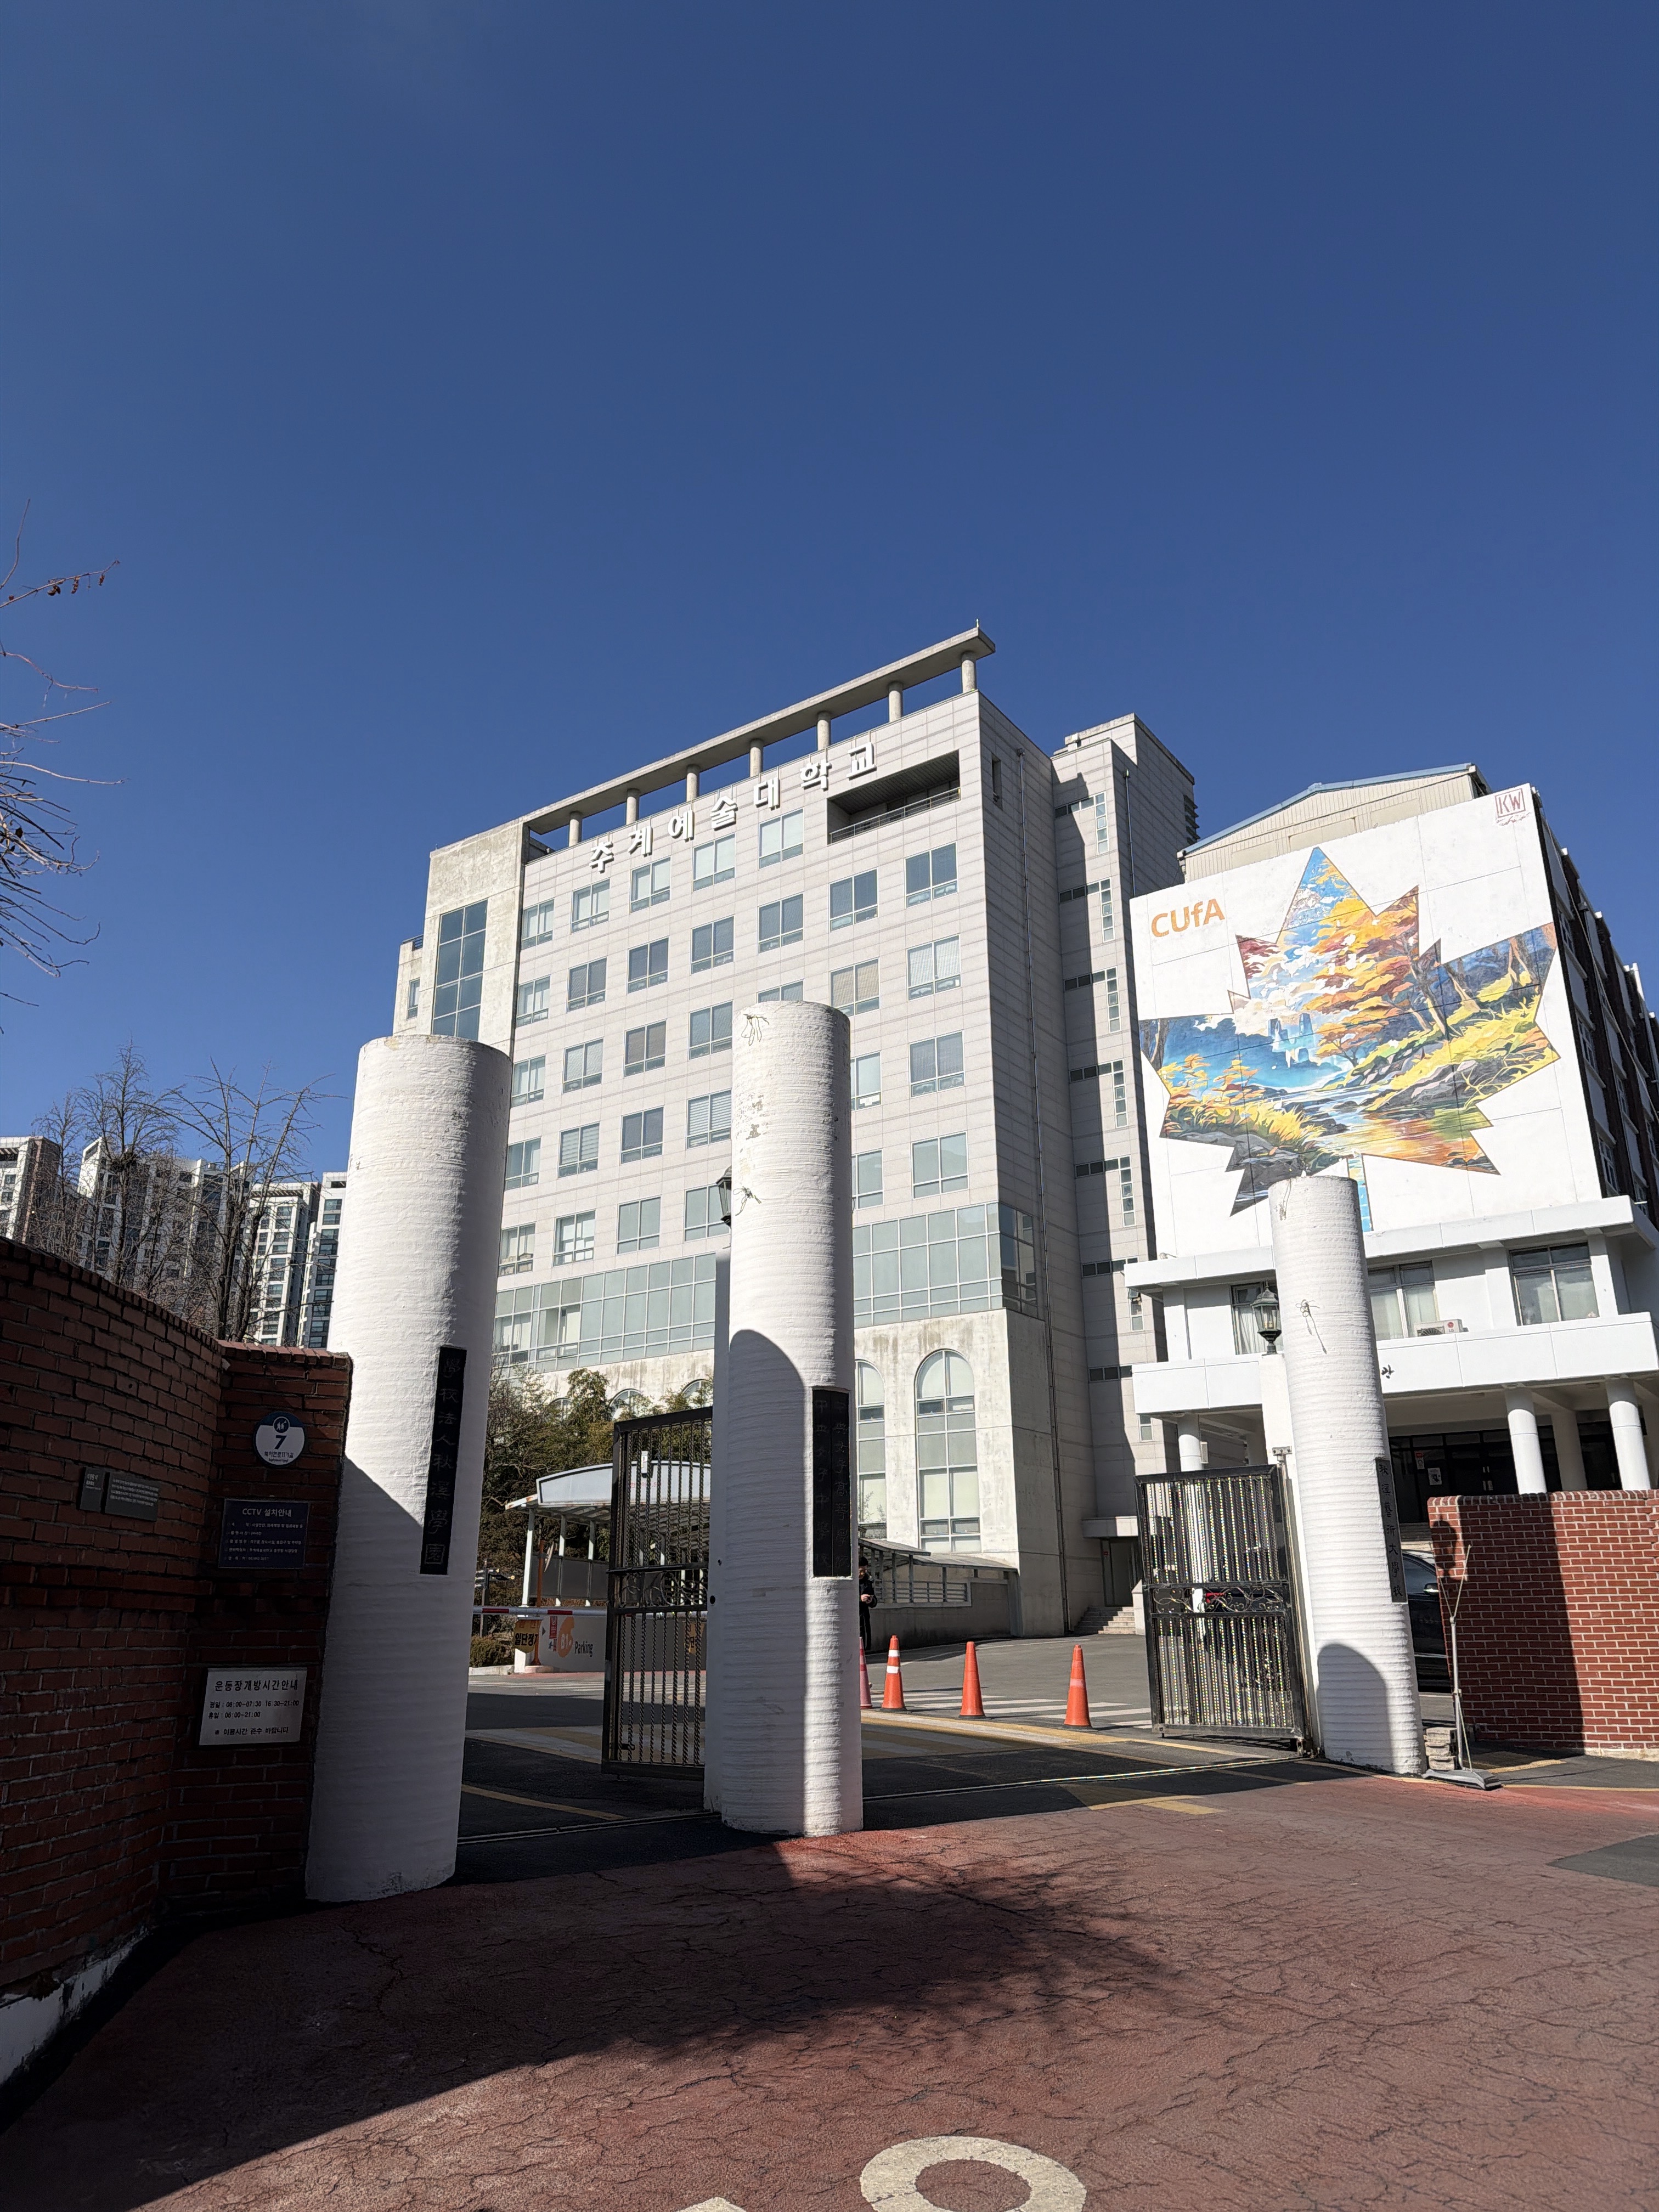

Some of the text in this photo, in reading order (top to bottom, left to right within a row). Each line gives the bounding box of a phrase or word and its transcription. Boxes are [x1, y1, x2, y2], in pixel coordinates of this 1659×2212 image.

[589, 742, 876, 872] 추계예술대학교
[1498, 792, 1520, 814] KW
[274, 1435, 287, 1449] 7
[242, 1508, 292, 1517] CCTV 설치안내
[574, 1640, 594, 1657] Parking
[215, 1679, 298, 1691] 운동장개방시간안내
